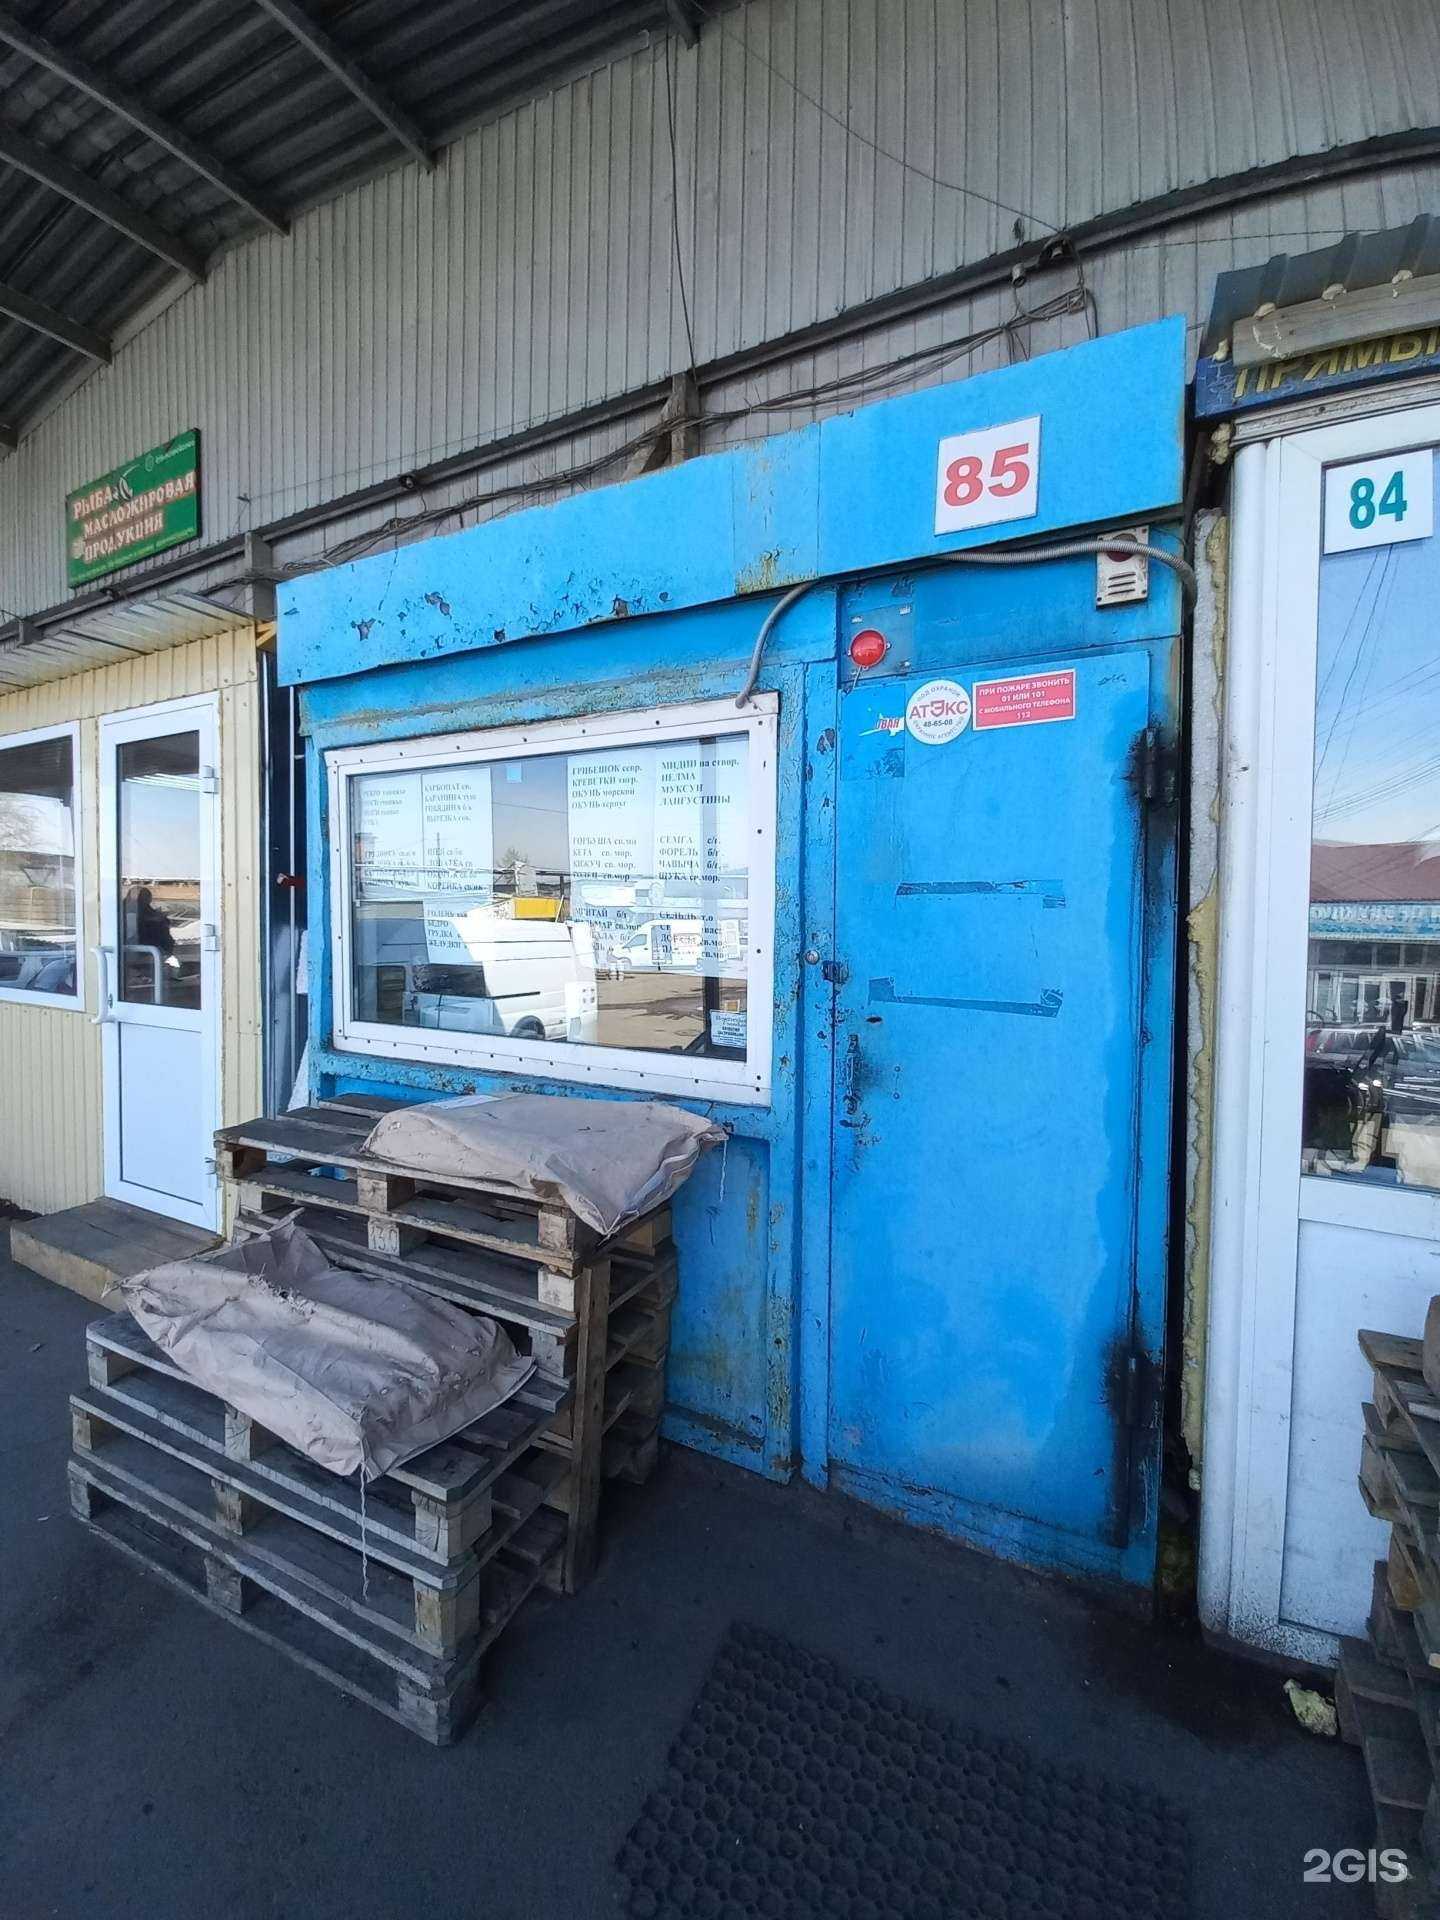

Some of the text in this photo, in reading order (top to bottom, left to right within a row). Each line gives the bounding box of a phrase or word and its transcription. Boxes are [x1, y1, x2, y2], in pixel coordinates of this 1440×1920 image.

[943, 443, 1031, 507] 85
[73, 486, 112, 519] РЫБА
[84, 471, 196, 538] МАСЛОЖИРОВАЯ
[1350, 471, 1407, 529] 84
[84, 512, 163, 562] ПРОДУКЦИЯ
[979, 678, 1070, 696] ПРИ ПОЖАРЕ ЗВОНИТЬ
[1012, 692, 1030, 701] ИЛИ
[1032, 691, 1045, 699] 101
[909, 699, 969, 720] АТЭКС
[984, 703, 1032, 714] МОБИЛЬНОГО
[1032, 697, 1070, 709] ТЕЛЕФОНА
[1016, 711, 1031, 719] 112
[661, 760, 697, 770] МИДИИ
[661, 773, 696, 782] НЕЛМА
[661, 784, 703, 794] МУКСУН
[661, 795, 731, 806] ЛАНГУСТИНЫ
[660, 847, 698, 857] ФОРЕЛЬ
